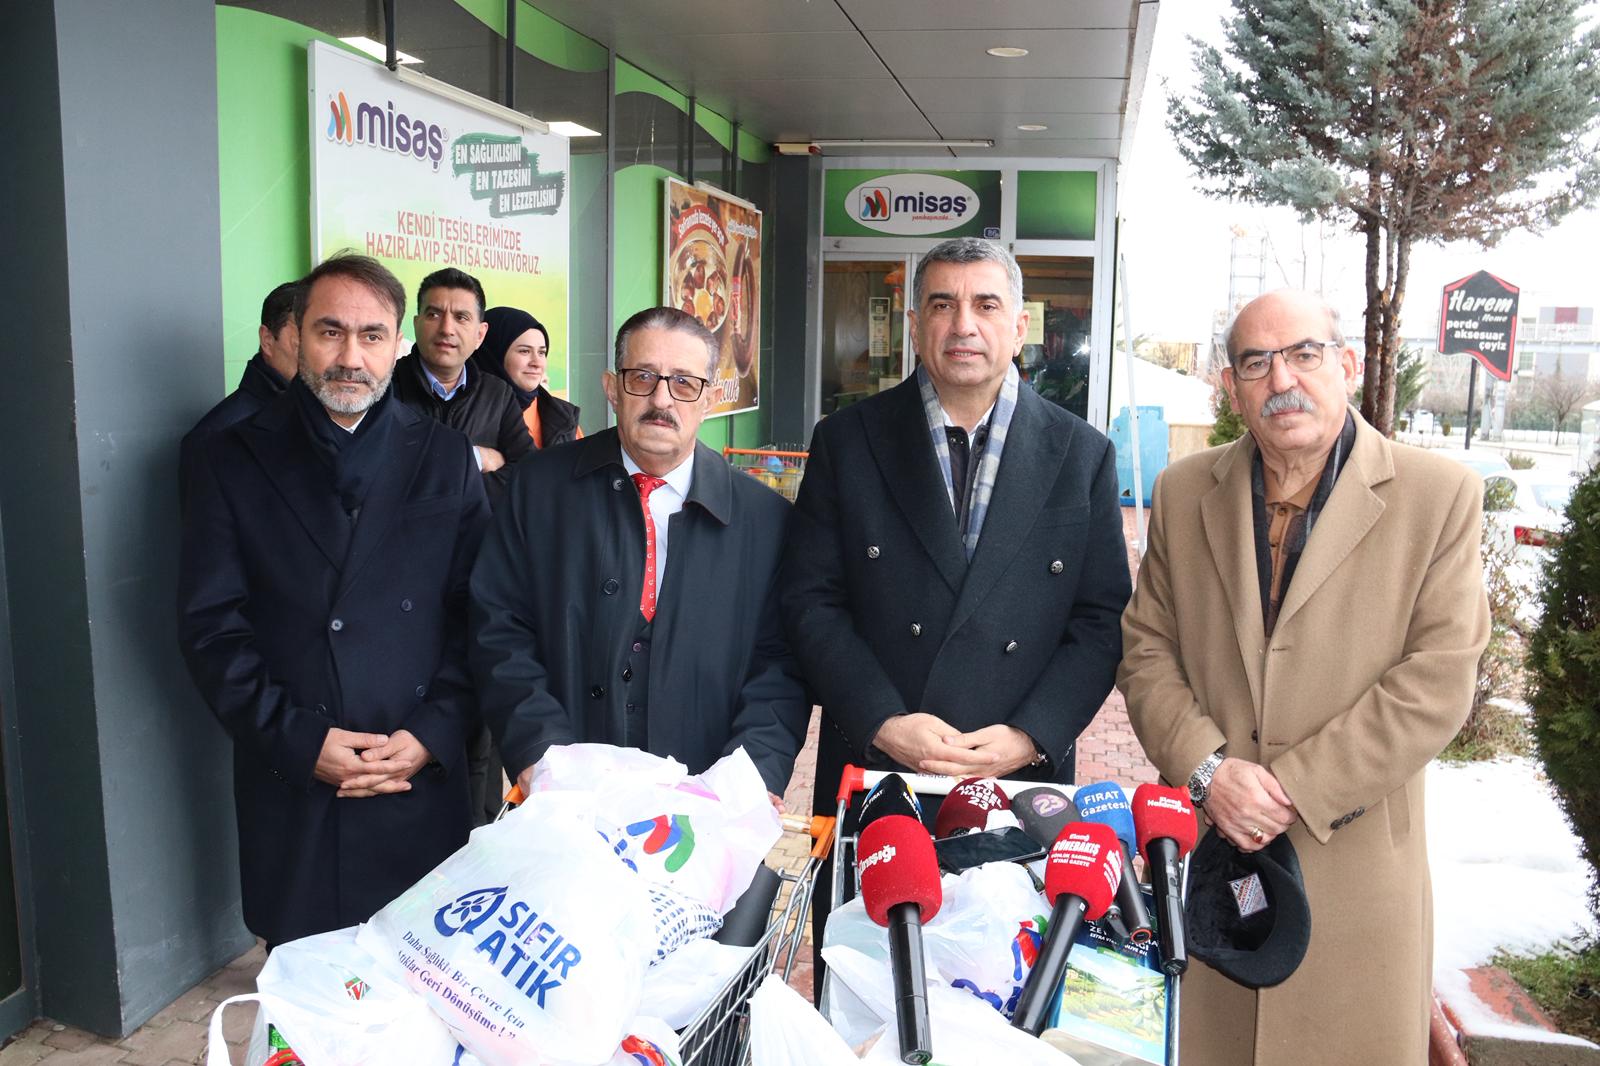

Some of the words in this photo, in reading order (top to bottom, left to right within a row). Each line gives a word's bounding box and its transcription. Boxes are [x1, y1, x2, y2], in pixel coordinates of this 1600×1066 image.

[357, 100, 443, 169] misaş
[455, 144, 468, 164] EN
[476, 171, 489, 191] EN
[492, 163, 531, 189] TAZESİNİ
[499, 193, 511, 213] EN
[512, 184, 557, 211] LEZZETLİSİNİ
[895, 191, 967, 217] misaş
[397, 210, 435, 239] KENDİ
[438, 216, 521, 251] TESİSLERİMİZDE
[366, 231, 440, 263] HAZIRLAYIP
[443, 242, 481, 272] SATIŞA
[483, 249, 542, 275] SUNUYORUZ.
[1448, 289, 1514, 312] Harem
[1446, 319, 1479, 330] perde
[1454, 329, 1504, 341] aksesuar
[1478, 341, 1507, 352] çeyiz
[960, 789, 996, 807] HABER
[967, 796, 989, 811] 23
[1033, 795, 1065, 814] 23
[1081, 801, 1129, 818] Gazetesi
[1083, 790, 1120, 805] FIRAT
[498, 901, 582, 980] SIFIR
[402, 931, 423, 952] Daha
[422, 946, 451, 974] Sağlıklı
[452, 970, 470, 988] Bir
[470, 985, 502, 1013] Çevre
[503, 1007, 526, 1029] İçin
[474, 929, 562, 1010] ATIK
[419, 969, 443, 993] Geri
[442, 986, 498, 1033] Dönüşüme
